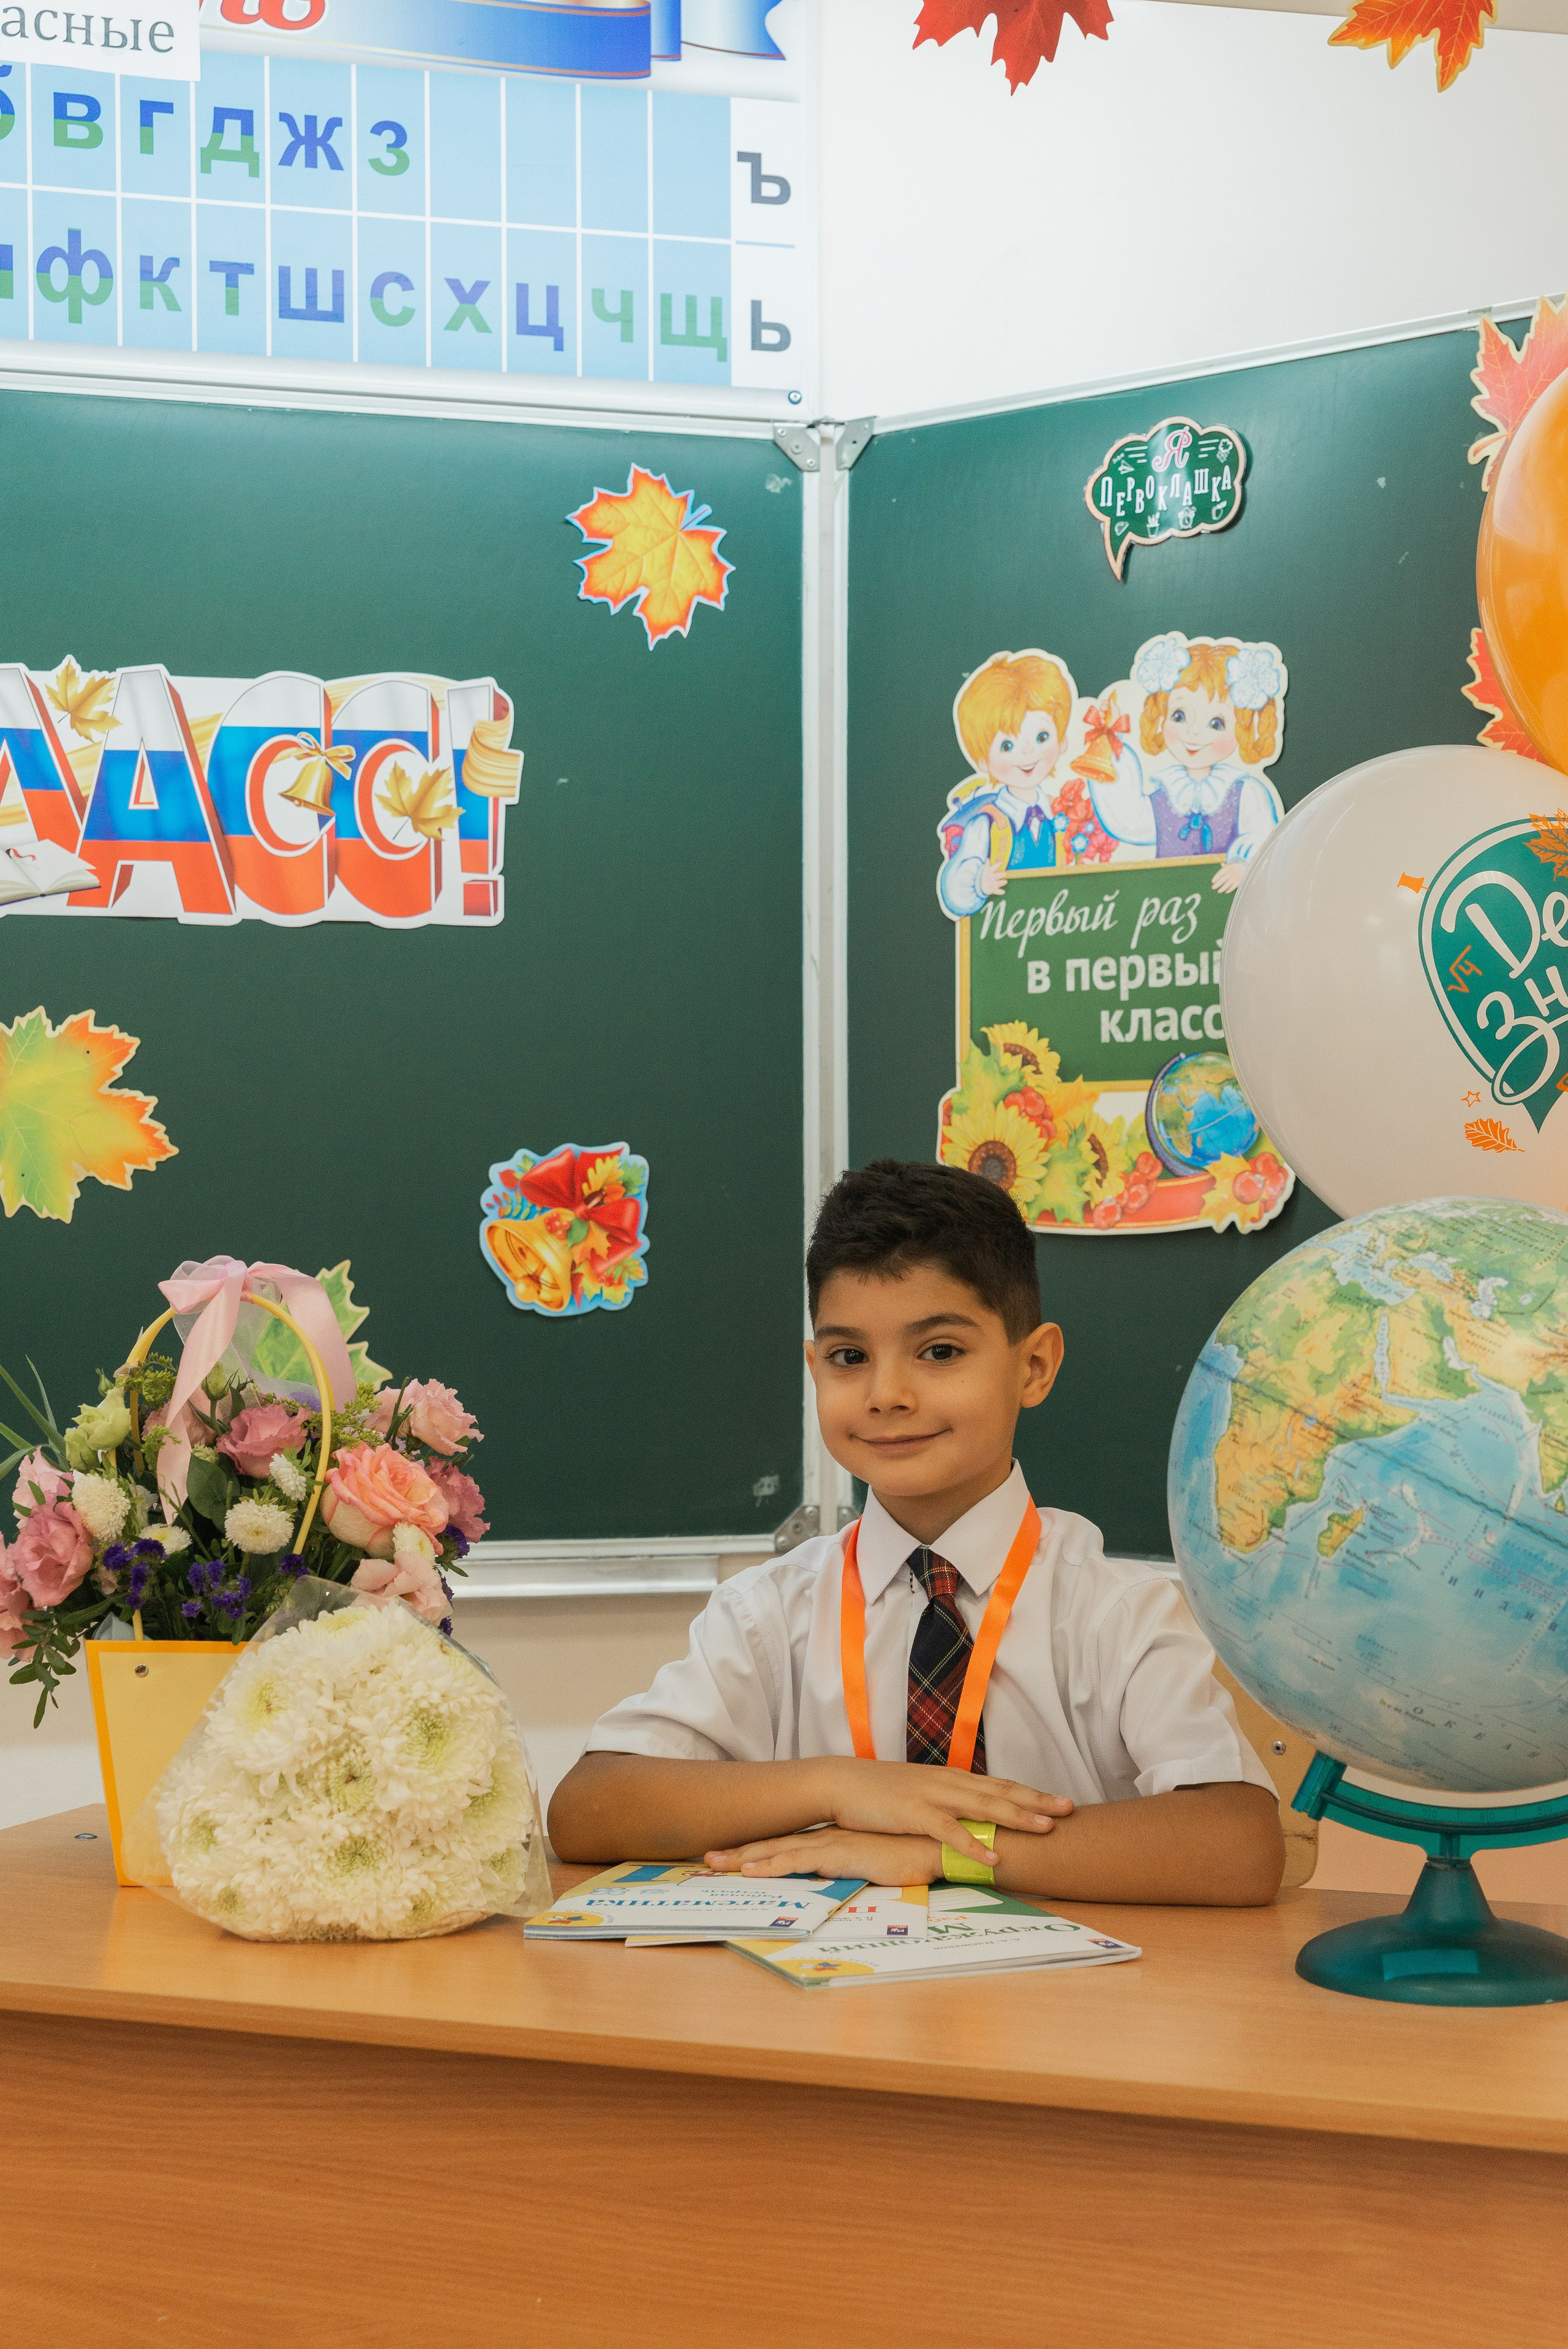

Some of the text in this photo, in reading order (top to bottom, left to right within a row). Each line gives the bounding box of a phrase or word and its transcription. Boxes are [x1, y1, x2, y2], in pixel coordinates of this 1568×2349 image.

[1152, 425, 1192, 472] Я
[1099, 465, 1232, 517] ПЕРВОКЛАШКА
[979, 888, 1202, 958] Первый раз
[1027, 960, 1051, 994] в
[1101, 1003, 1225, 1044] класс
[586, 1898, 815, 1910] Математика
